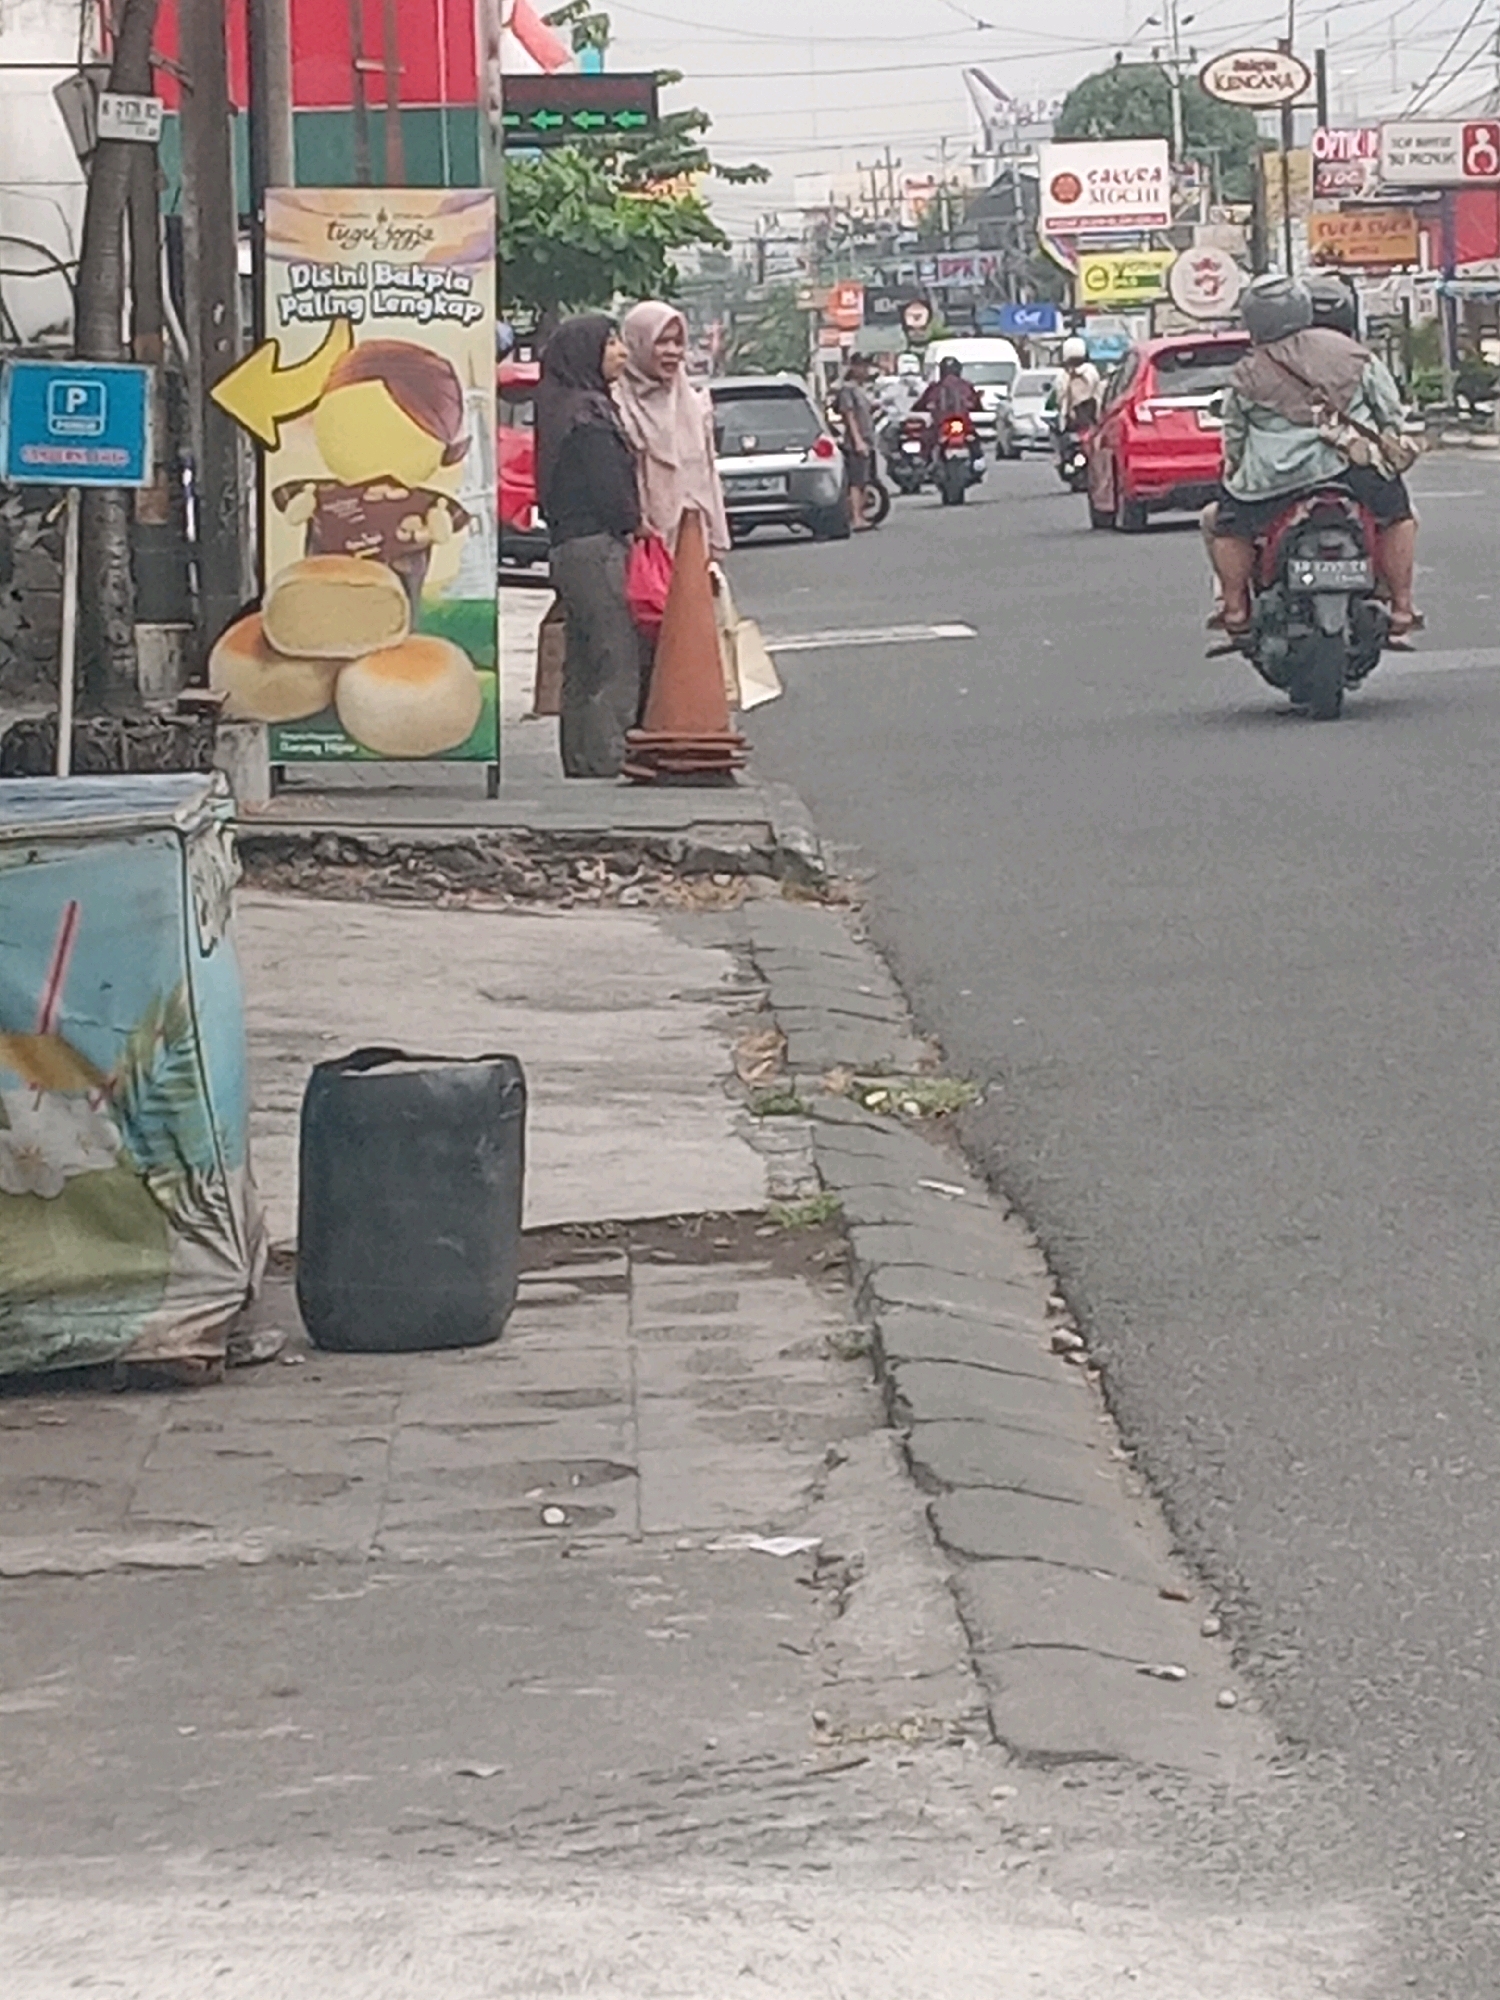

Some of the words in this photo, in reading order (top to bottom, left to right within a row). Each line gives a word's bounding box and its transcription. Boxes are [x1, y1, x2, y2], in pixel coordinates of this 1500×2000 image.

[1213, 72, 1296, 92] KENCANA
[1086, 166, 1162, 186] SAKURA
[1088, 187, 1160, 205] MOCHI
[326, 220, 376, 250] tugu
[289, 262, 367, 290] Disini
[373, 262, 472, 295] Bakpia
[279, 294, 365, 324] Paling
[372, 290, 484, 325] Lengkap
[66, 386, 88, 413] P
